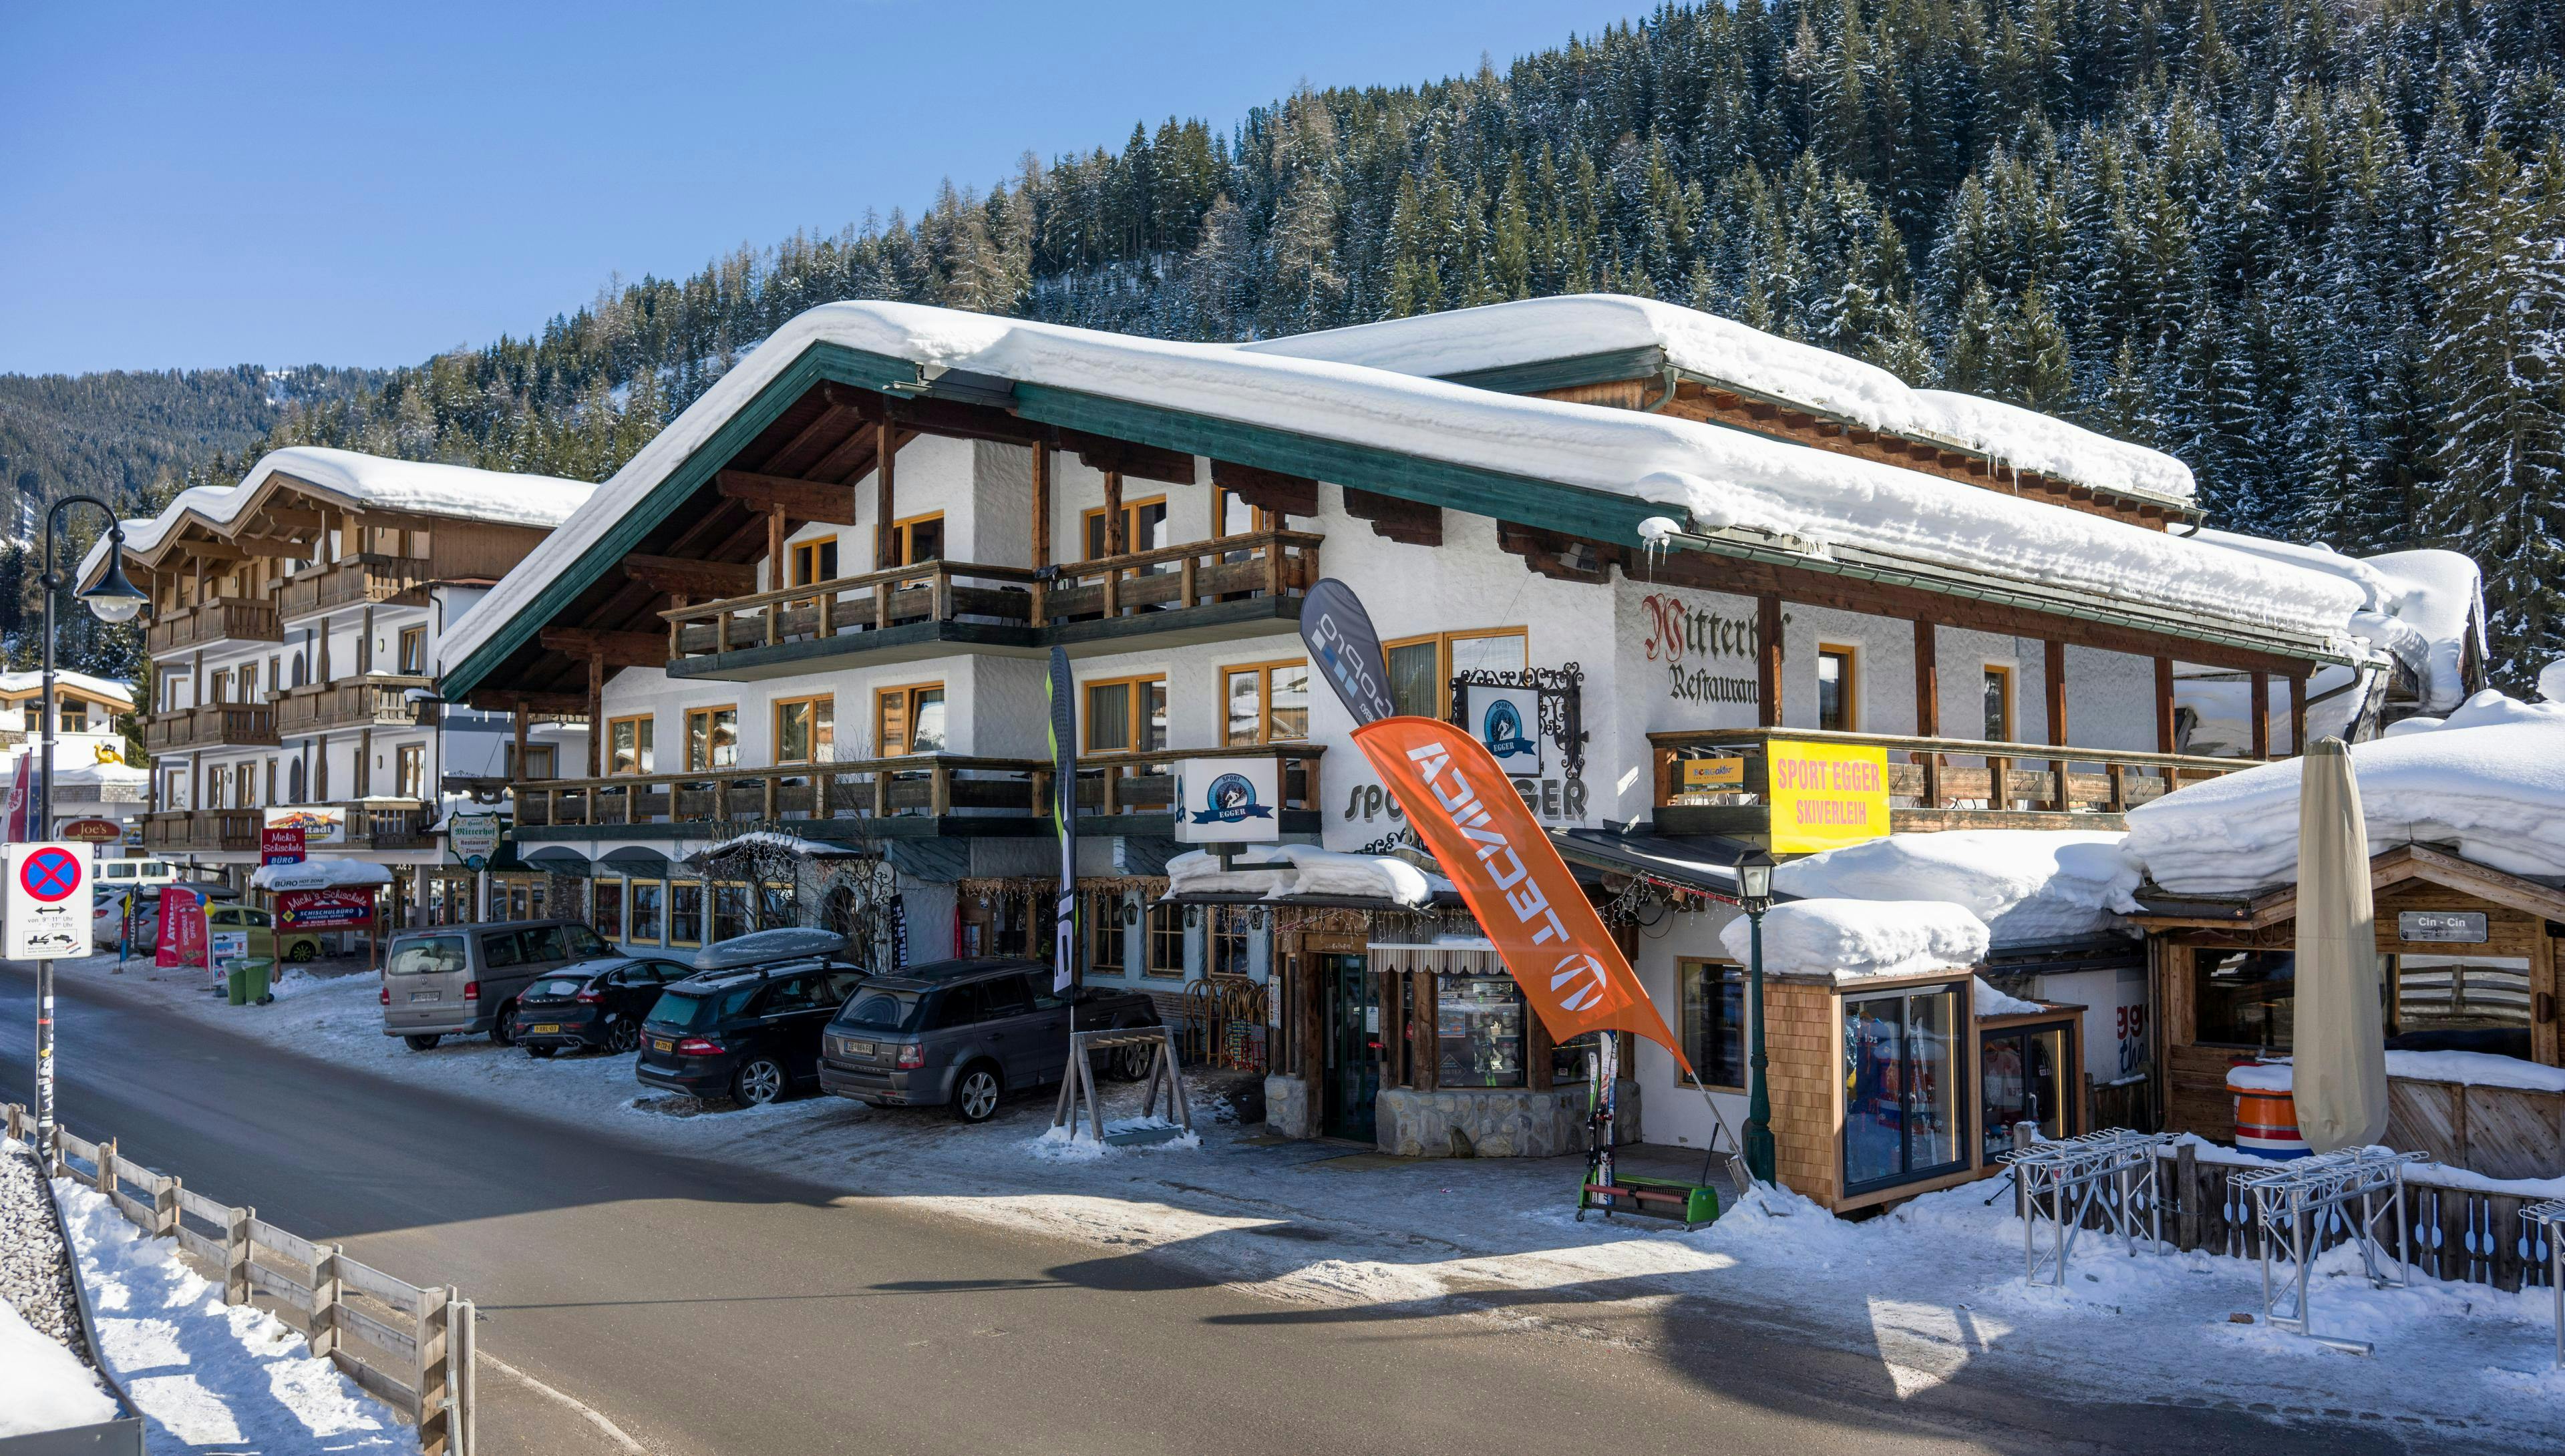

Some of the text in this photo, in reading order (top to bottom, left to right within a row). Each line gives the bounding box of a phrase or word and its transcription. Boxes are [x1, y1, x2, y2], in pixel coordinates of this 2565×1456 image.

[1642, 593, 1793, 664] Mitterhf
[1669, 663, 1759, 707] Restauran
[1493, 741, 1515, 752] EGGER
[1777, 758, 1880, 791] SPORT EGGER
[1344, 779, 1590, 823] SPO GER
[1219, 808, 1246, 818] EGGER
[1796, 799, 1867, 825] SKIVERLEIH
[80, 823, 107, 835] Joe's
[454, 828, 496, 836] Mitterhof
[272, 832, 297, 843] Michi's
[263, 843, 303, 852] Schischule
[271, 856, 294, 864] BÜRO
[275, 879, 298, 888] BÜRO
[323, 889, 367, 906] Schischule
[300, 908, 354, 916] SCHISCHULBÜRO
[2418, 917, 2437, 926] Cin
[2447, 918, 2466, 927] Cin
